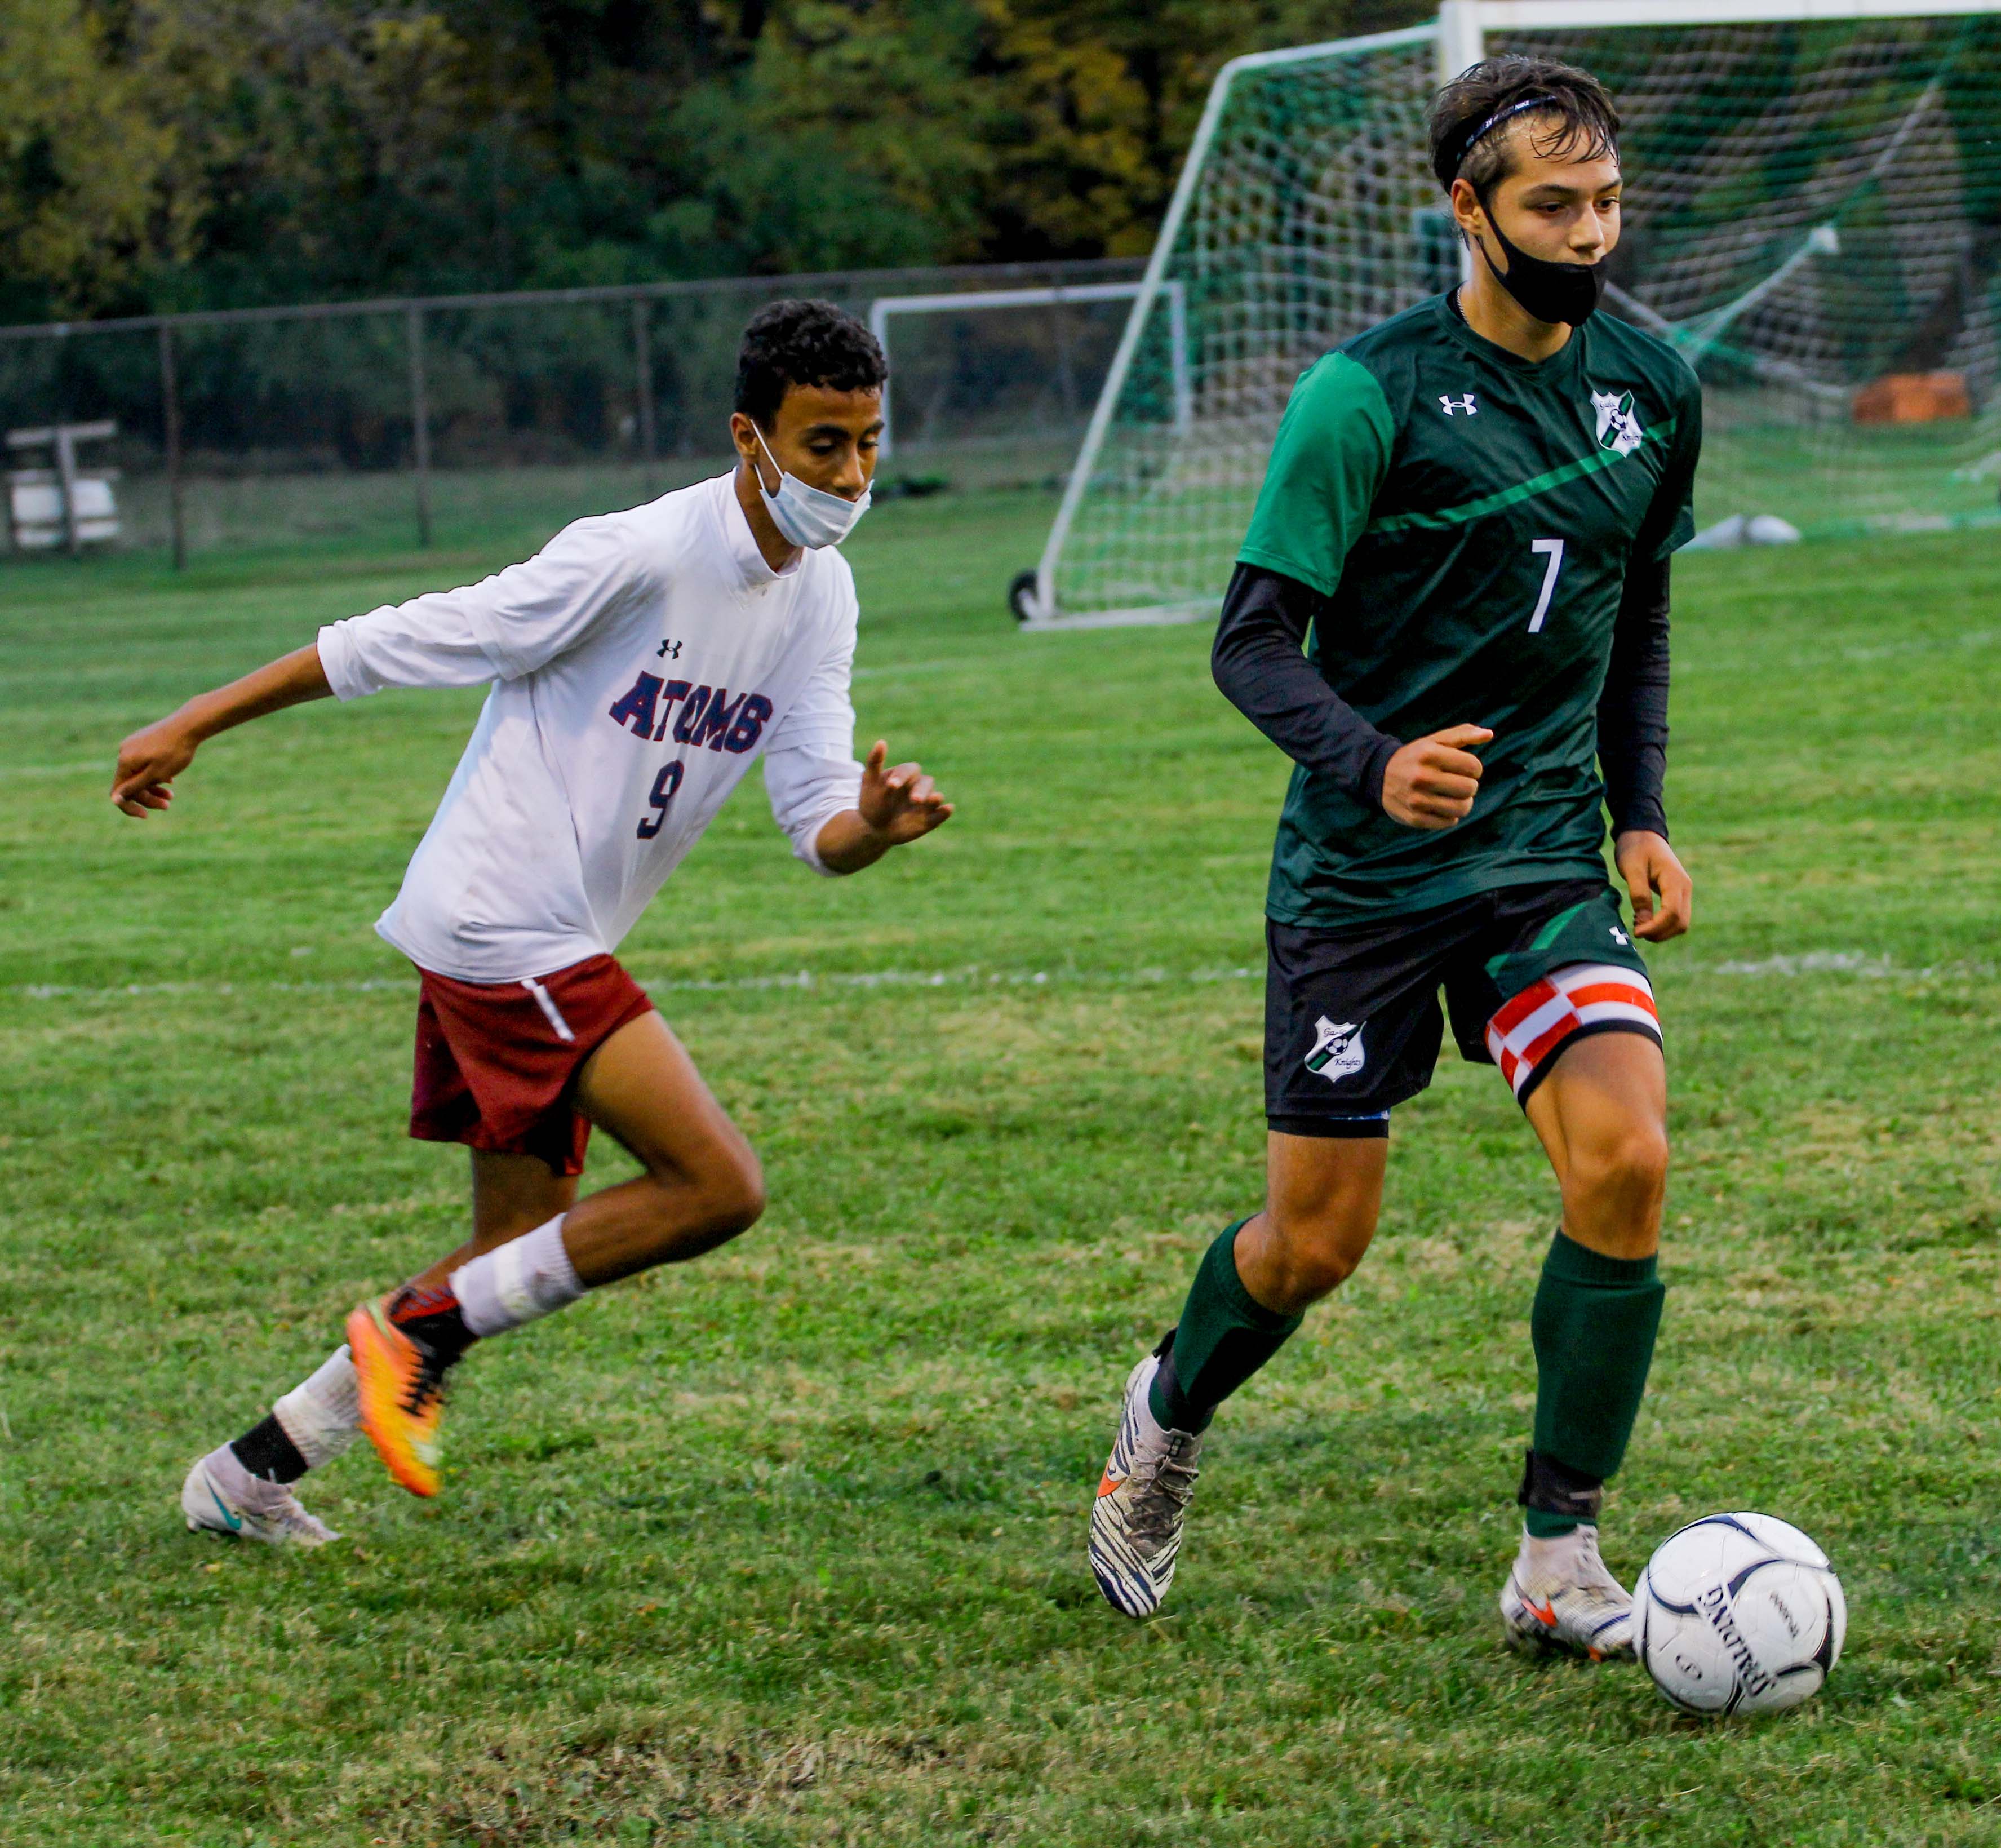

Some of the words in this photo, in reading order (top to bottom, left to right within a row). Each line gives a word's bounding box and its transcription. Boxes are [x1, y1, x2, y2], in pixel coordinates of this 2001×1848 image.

[1515, 100, 1530, 110] NIKE
[1528, 539, 1564, 633] 7
[609, 671, 773, 754] ATOMS
[637, 760, 684, 839] 9
[1334, 1057, 1361, 1069] Knights
[1697, 1584, 1777, 1696] SPALDING
